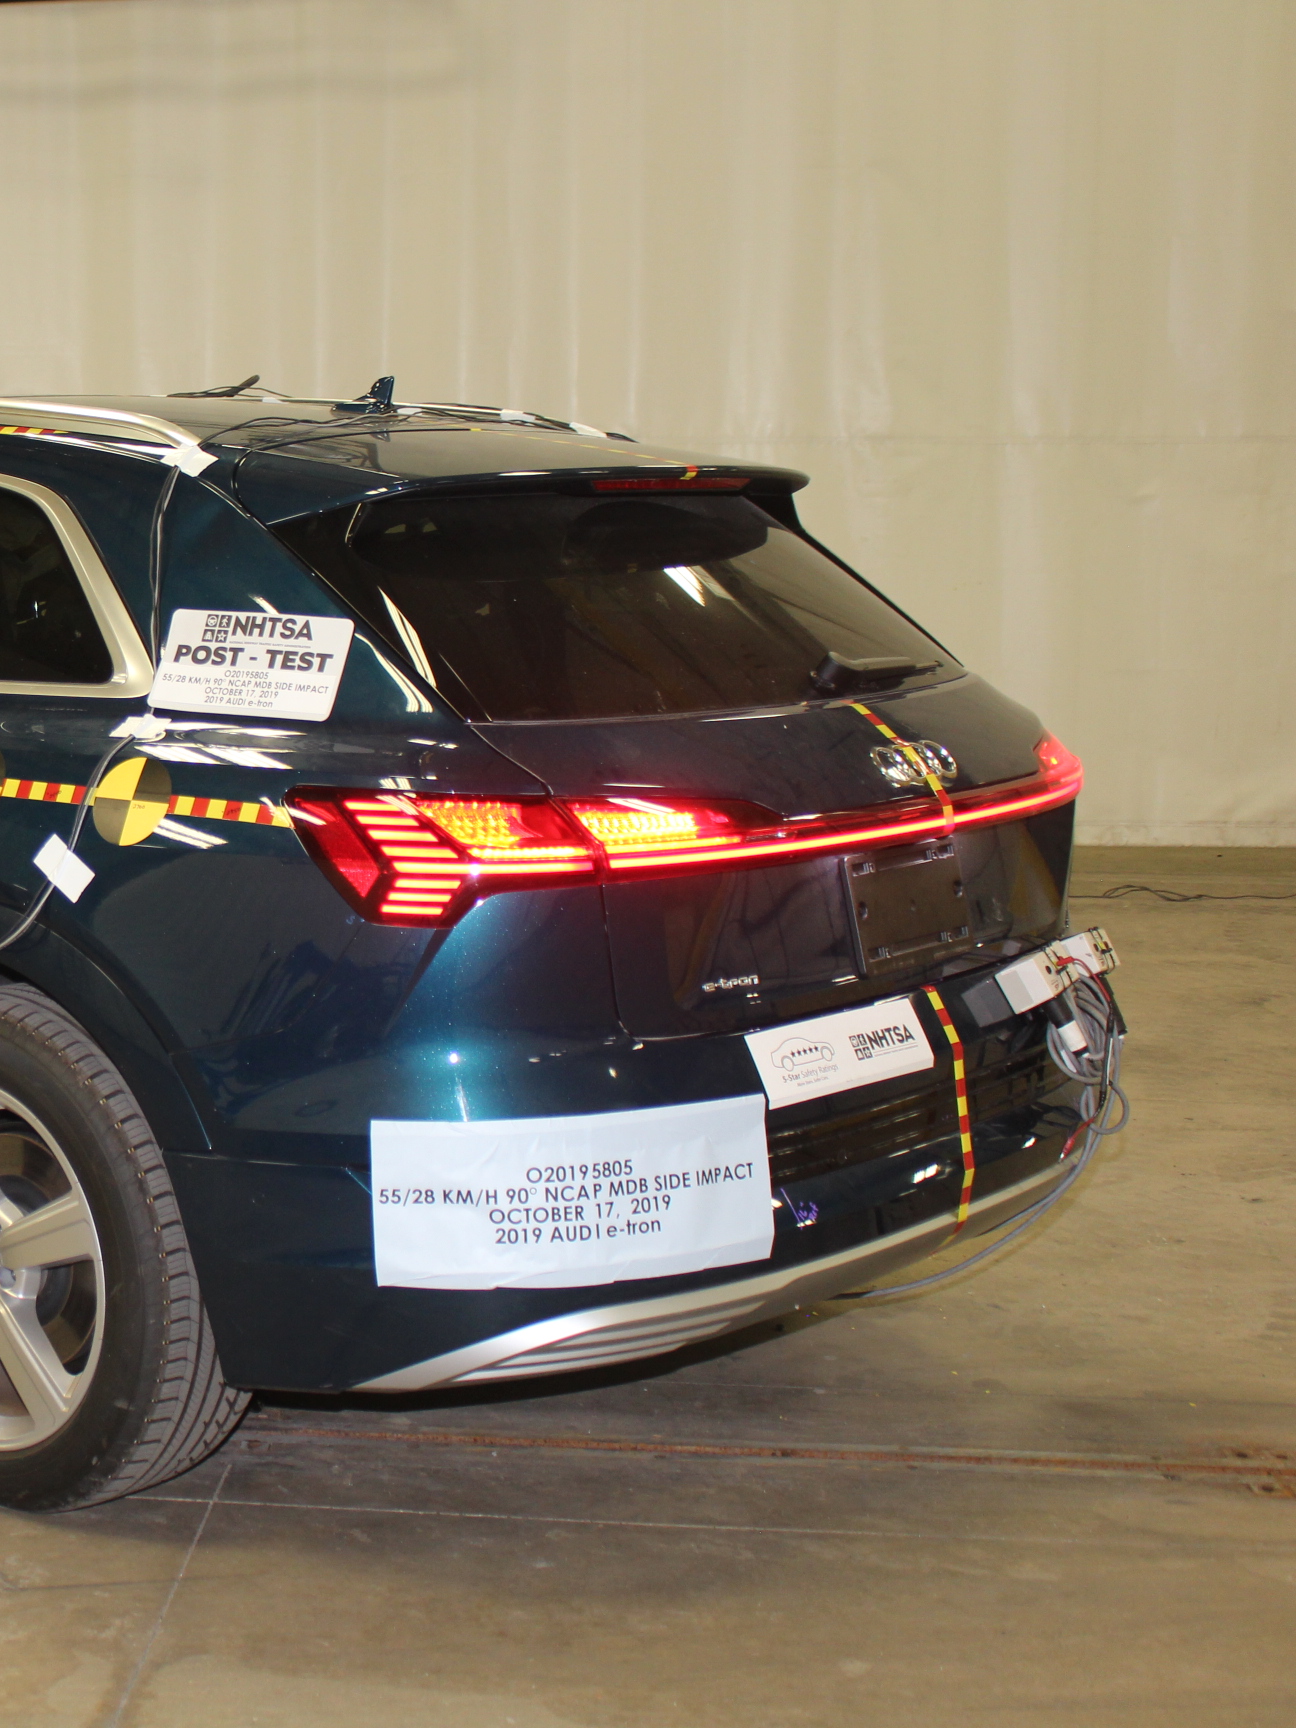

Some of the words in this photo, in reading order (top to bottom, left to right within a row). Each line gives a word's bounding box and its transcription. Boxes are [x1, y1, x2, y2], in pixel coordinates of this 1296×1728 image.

[231, 615, 313, 641] NHTSA
[173, 644, 246, 667] POST
[266, 649, 335, 673] TEST
[162, 673, 186, 684] 55/28
[188, 676, 211, 686] KM/H
[227, 680, 252, 689] NCAP
[254, 681, 272, 690] MDB
[274, 682, 293, 691] SIDE
[294, 683, 330, 695] IMPACT
[204, 686, 244, 697] OCTOBER
[258, 690, 279, 699] 2019
[204, 695, 225, 705] 2019
[225, 698, 246, 707] AUDI
[247, 699, 273, 708] e-tron
[702, 974, 760, 993] e-tron
[864, 1023, 916, 1050] NHTSA
[378, 1188, 436, 1208] 55/28
[442, 1188, 498, 1208] KM/H
[544, 1183, 603, 1204] NCAP
[608, 1178, 649, 1198] MDB
[654, 1172, 691, 1192] SIDE
[696, 1162, 754, 1187] IMPACT
[489, 1205, 585, 1225] OCTOBER
[595, 1201, 621, 1220] 17,
[630, 1194, 672, 1216] 2019
[495, 1227, 543, 1245] 2019
[550, 1223, 600, 1244] AUDI
[606, 1219, 662, 1239] e-tron
